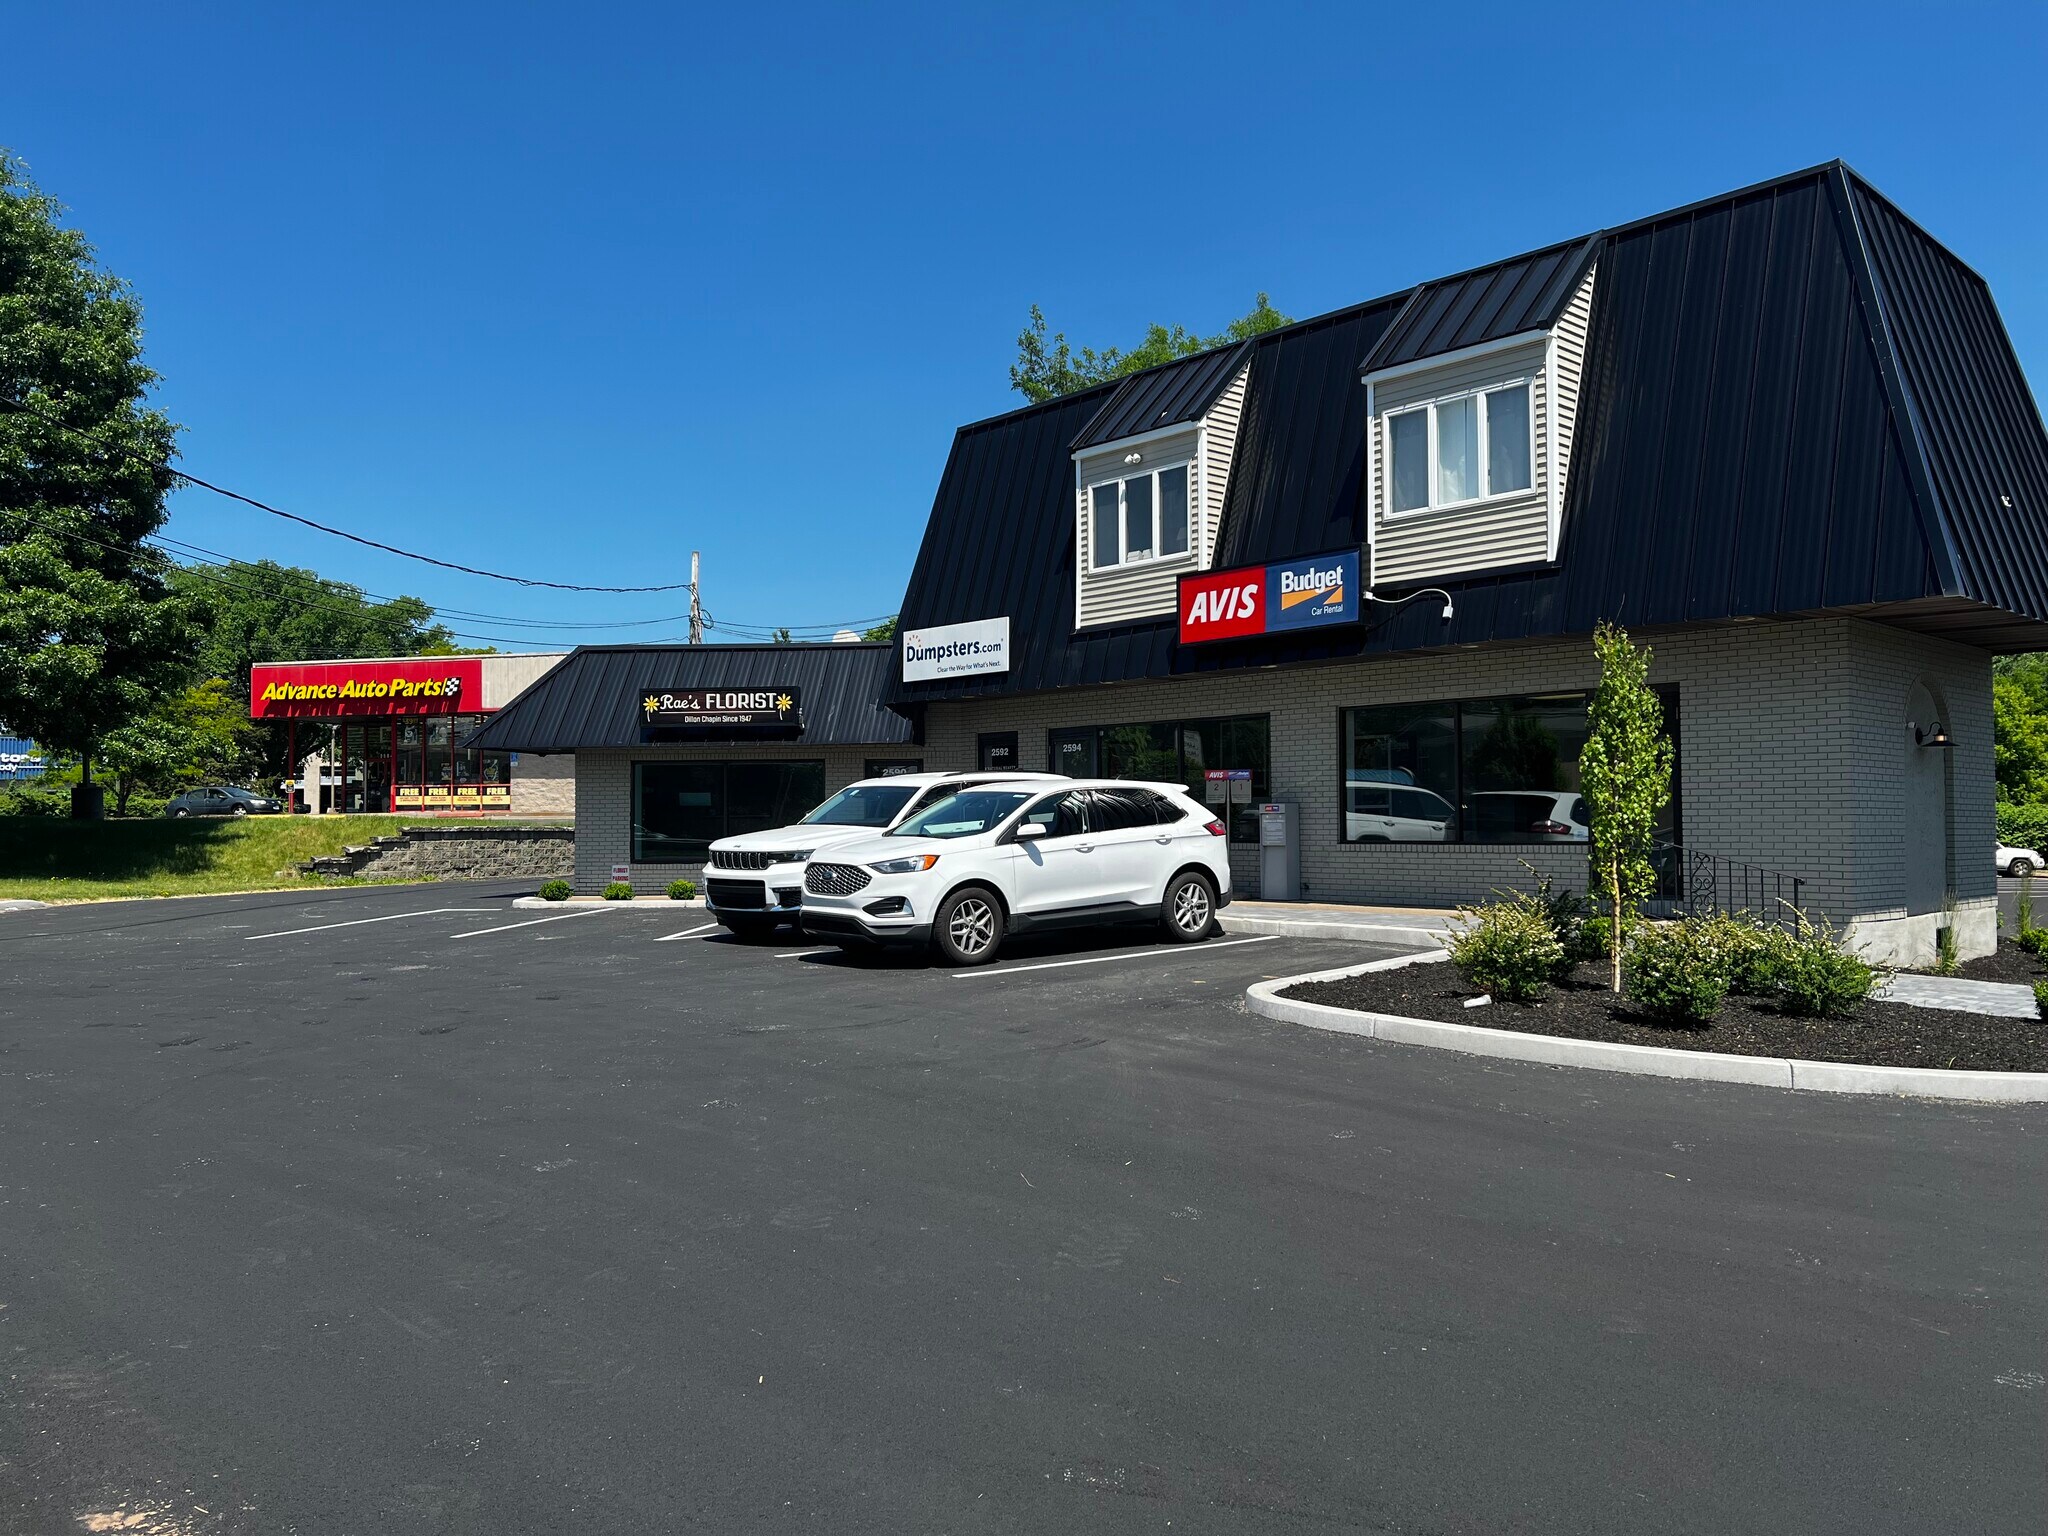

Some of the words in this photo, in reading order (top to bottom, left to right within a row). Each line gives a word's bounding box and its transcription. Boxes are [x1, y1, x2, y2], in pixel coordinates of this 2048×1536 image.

[1281, 565, 1344, 594] Budget
[1186, 583, 1259, 625] AVIS
[1311, 607, 1323, 616] Car
[1323, 604, 1344, 614] Rental
[906, 641, 1001, 663] Dumpsters.com
[973, 661, 989, 669] What's
[260, 681, 338, 700] Advance
[338, 680, 389, 698] Auto
[389, 678, 442, 697] Parts
[660, 694, 701, 710] Rae's
[705, 692, 777, 709] FLORIST
[684, 715, 701, 723] Dillon
[701, 715, 722, 724] Chapin
[722, 715, 738, 723] Since
[991, 747, 1009, 756] 2592
[1062, 743, 1082, 752] 2594
[1209, 771, 1224, 779] AVIS
[428, 787, 448, 796] FREE
[457, 787, 478, 795] FREE
[486, 787, 507, 795] FREE
[1214, 783, 1219, 791] 2
[400, 788, 420, 796] FREE
